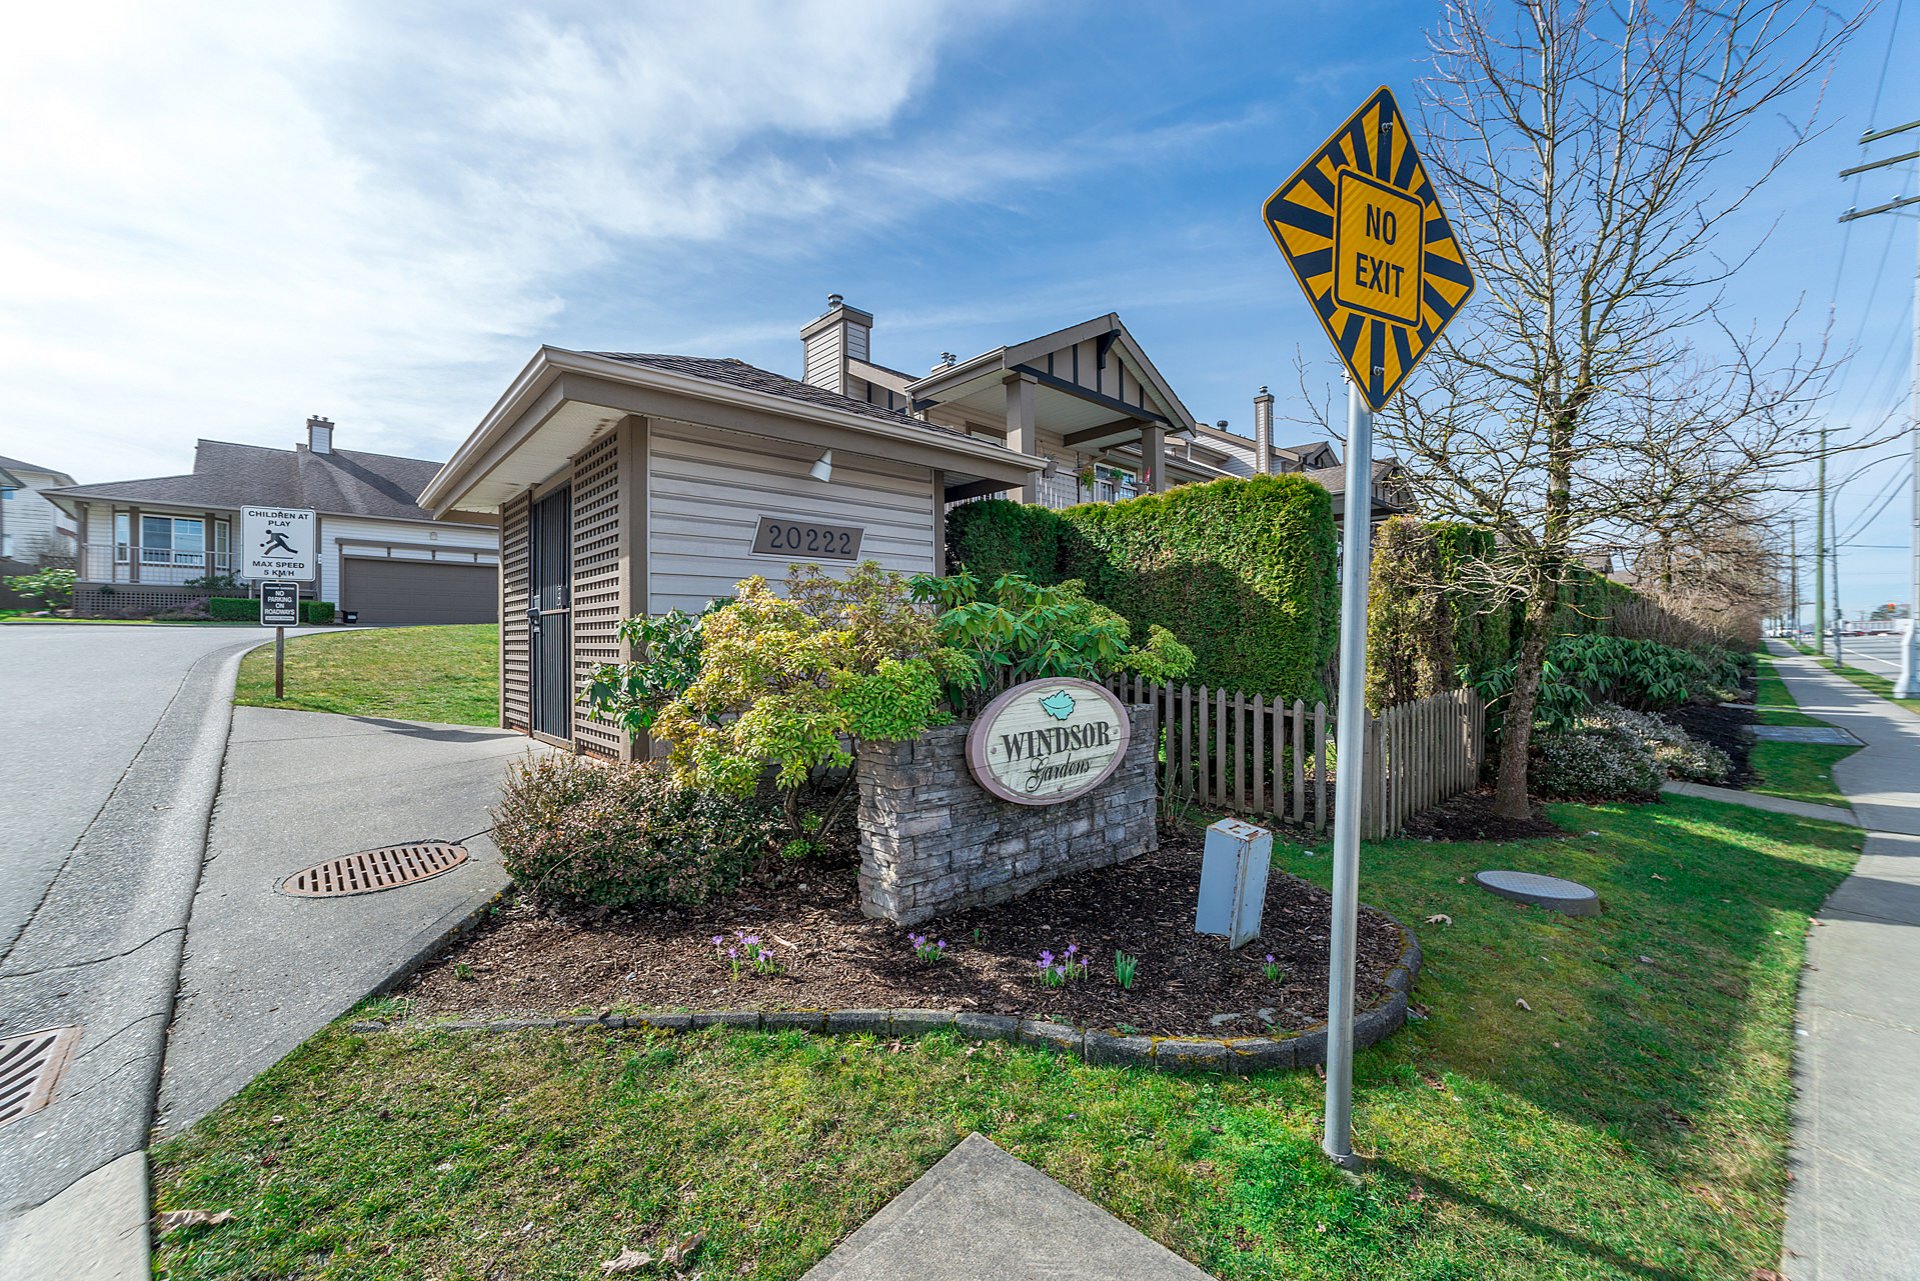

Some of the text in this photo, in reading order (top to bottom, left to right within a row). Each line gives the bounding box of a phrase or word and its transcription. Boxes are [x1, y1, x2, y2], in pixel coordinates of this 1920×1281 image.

[1366, 203, 1397, 246] NO
[1355, 251, 1405, 298] EXIT
[248, 510, 296, 519] CHILDREN
[768, 524, 852, 555] 20222
[271, 569, 295, 577] KM/H
[275, 561, 305, 569] SPEED
[264, 608, 295, 616] ROADWAYS
[1001, 720, 1111, 763] WINDSOR
[1024, 752, 1093, 793] Gardens
